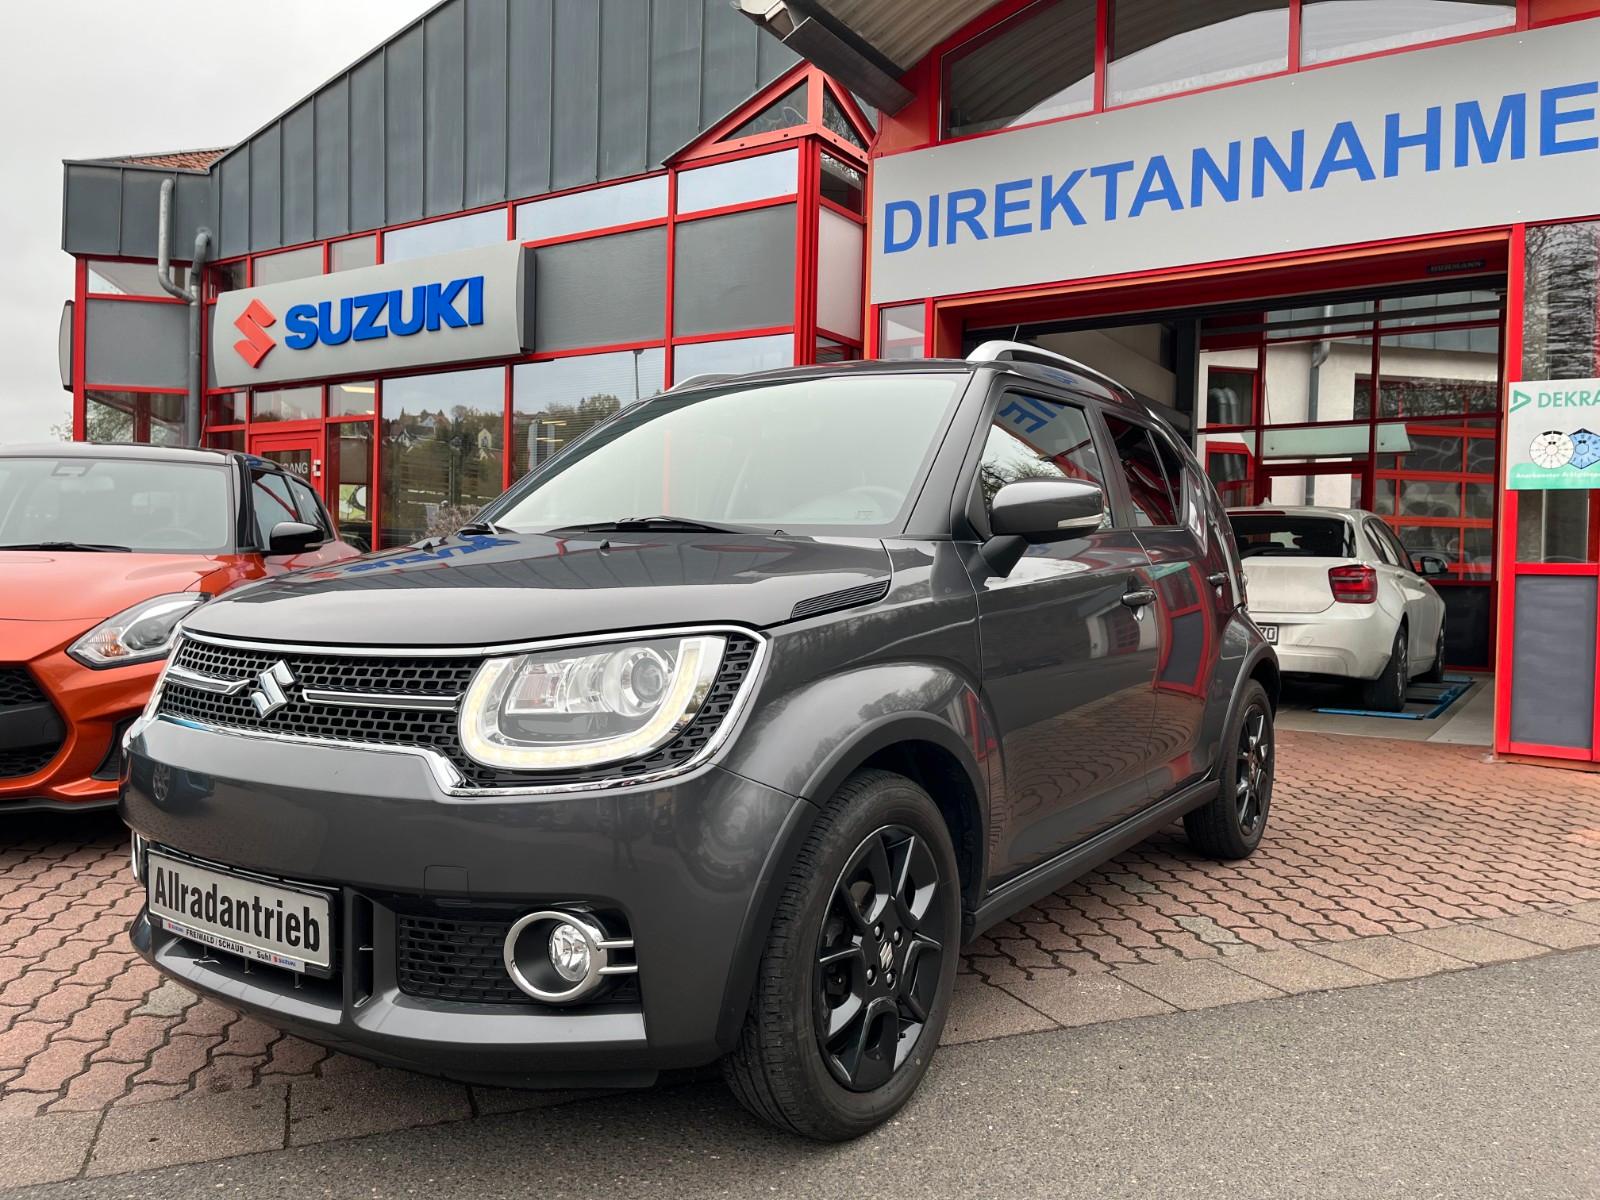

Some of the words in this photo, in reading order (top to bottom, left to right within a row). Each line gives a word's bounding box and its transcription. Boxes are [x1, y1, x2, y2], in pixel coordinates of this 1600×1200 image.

[883, 81, 1600, 254] DIREKTANNAHME
[284, 275, 485, 350] SUZUKI
[154, 866, 320, 953] Allradantrieb
